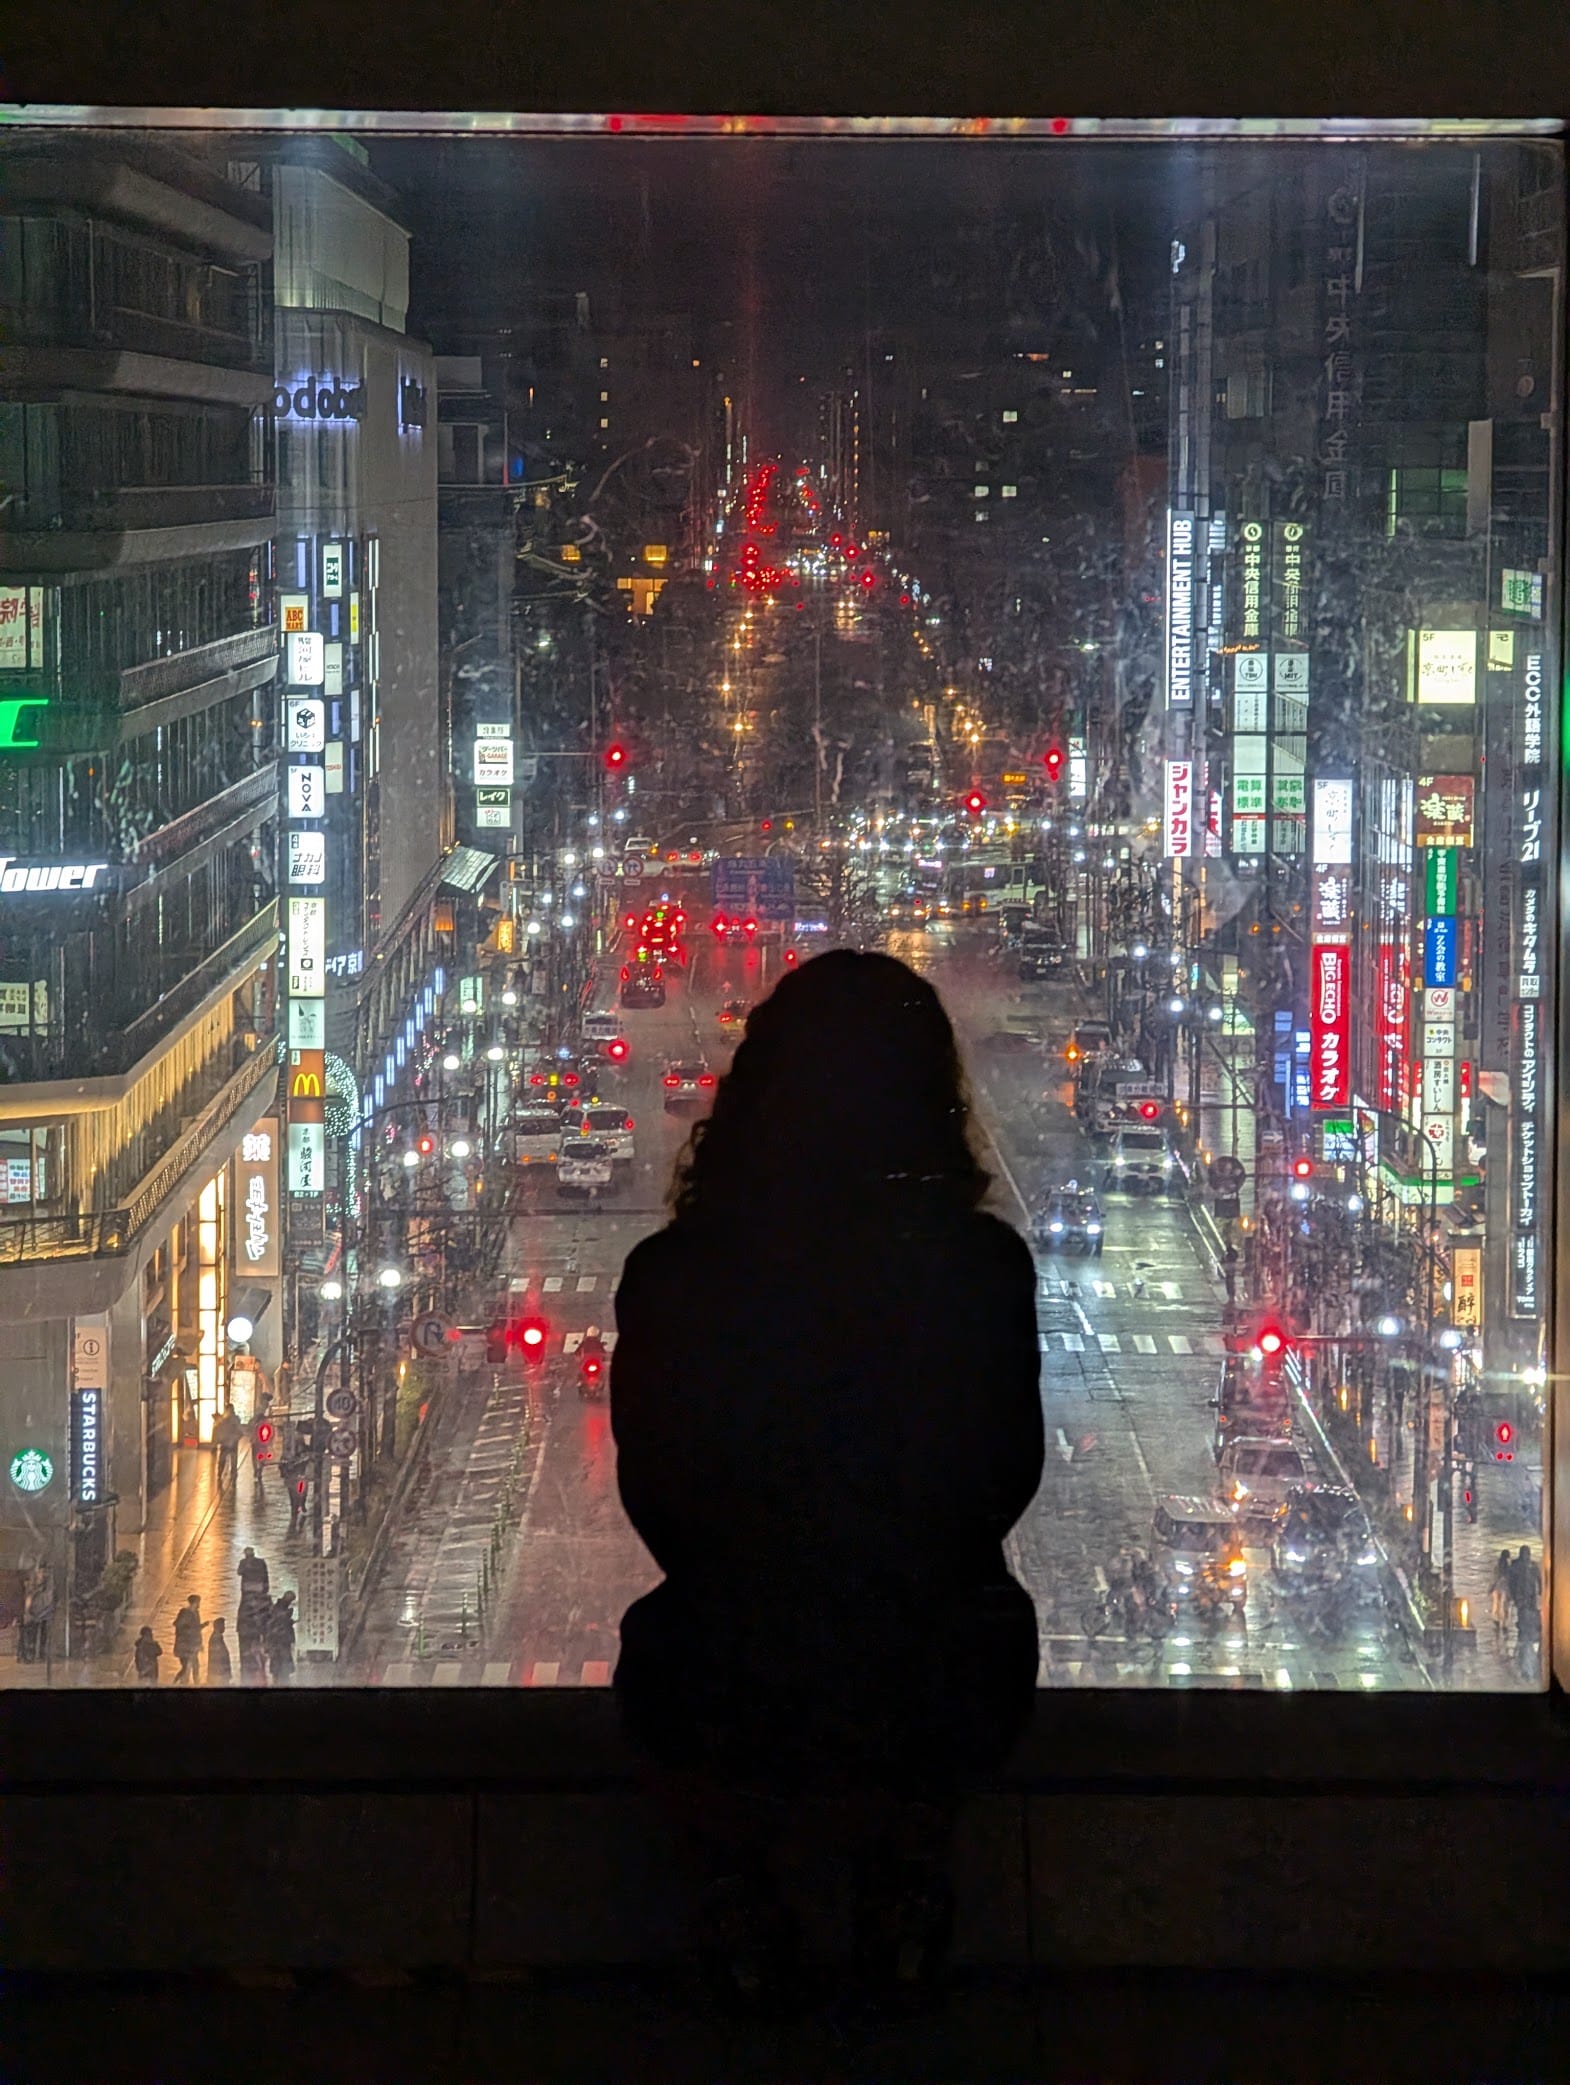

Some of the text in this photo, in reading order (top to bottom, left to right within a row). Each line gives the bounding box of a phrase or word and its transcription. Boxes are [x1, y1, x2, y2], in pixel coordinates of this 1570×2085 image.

[287, 610, 304, 622] ABC
[1171, 519, 1193, 700] ENTERTAINMENT HUB
[1243, 553, 1261, 637] 中央信用金庫
[1423, 632, 1436, 641] 5F
[1524, 655, 1542, 764] ECC外語学院
[301, 772, 312, 812] NOVA
[479, 791, 506, 802] レイク
[1171, 763, 1189, 854] ジャンカラ
[1418, 776, 1434, 787] 4F
[1521, 789, 1542, 862] リーブ21
[1315, 864, 1328, 873] 4F
[1522, 889, 1538, 974] カメラのキタムラ
[1321, 952, 1338, 1024] BIG ECHO
[1319, 1032, 1340, 1101] カラオケ
[1426, 1036, 1452, 1044] コンタクト
[82, 1392, 97, 1501] STARBUCKS
